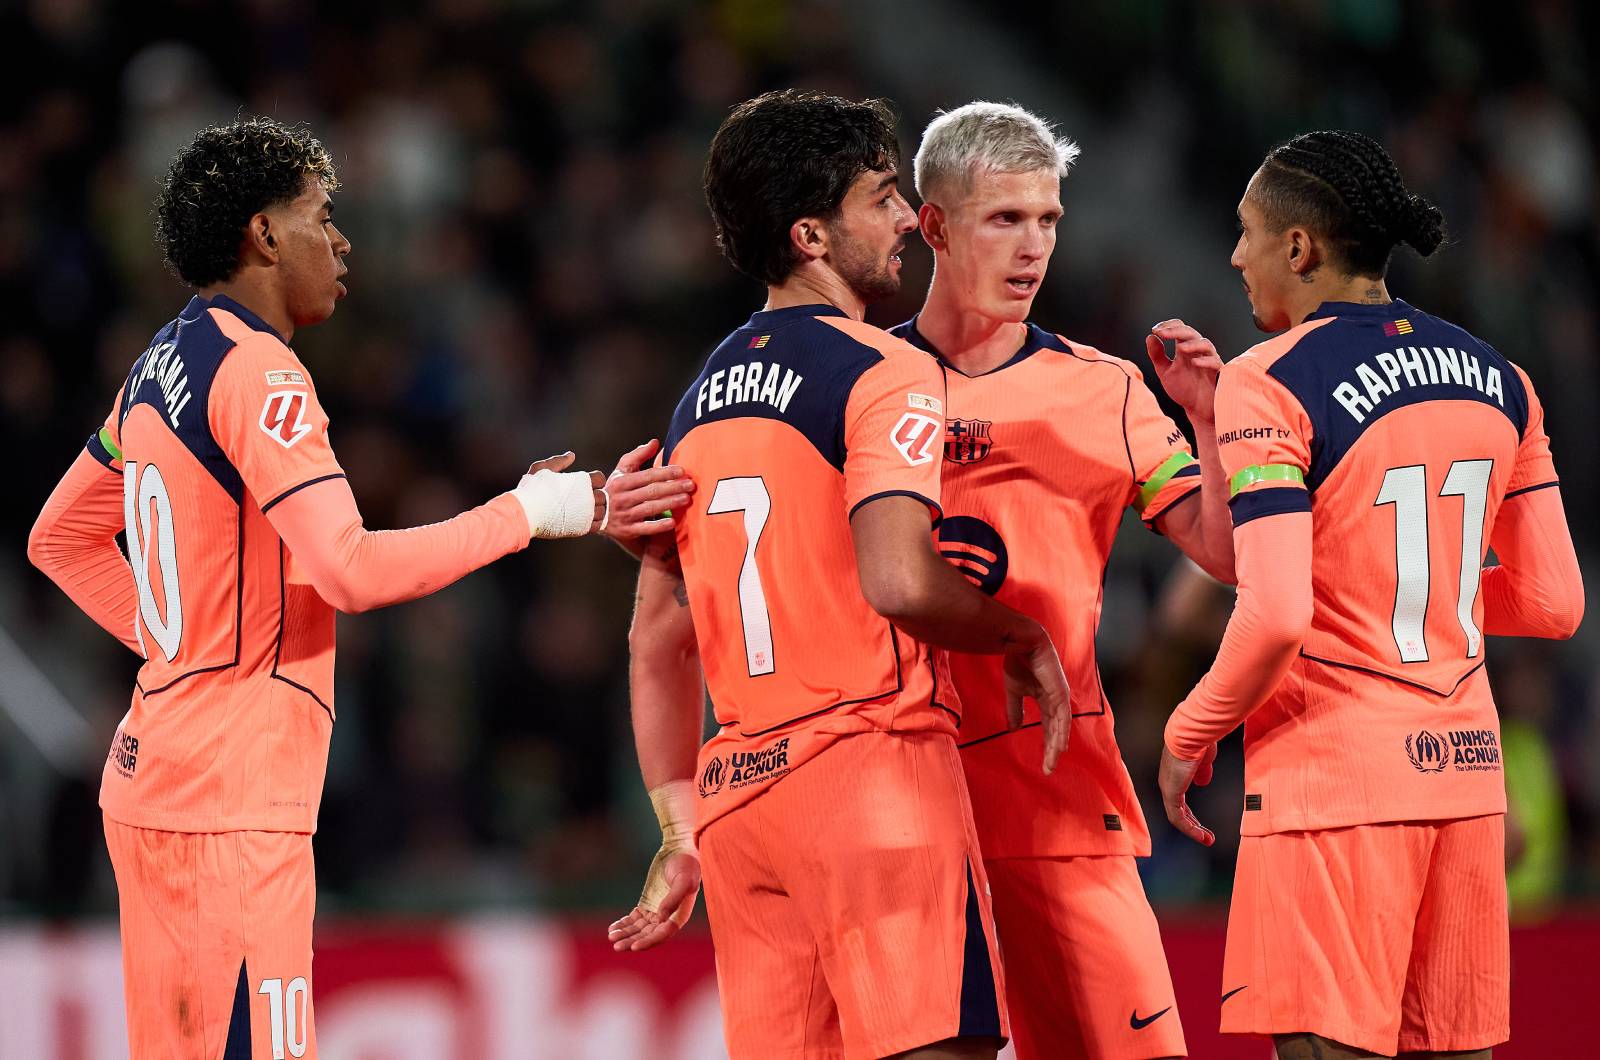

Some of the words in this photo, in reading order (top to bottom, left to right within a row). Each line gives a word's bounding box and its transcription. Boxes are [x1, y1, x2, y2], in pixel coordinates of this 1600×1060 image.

[695, 361, 803, 420] FERRAN
[1332, 346, 1504, 424] RAPHINHA
[1276, 430, 1291, 439] tv
[123, 461, 183, 663] 10
[706, 475, 772, 678] 7
[1373, 458, 1494, 663] 11
[729, 751, 788, 784] ACNUR
[732, 737, 790, 768] UNHCR
[1448, 730, 1496, 747] UNHCR
[1454, 748, 1500, 764] ACNUR
[257, 976, 308, 1060] 10
